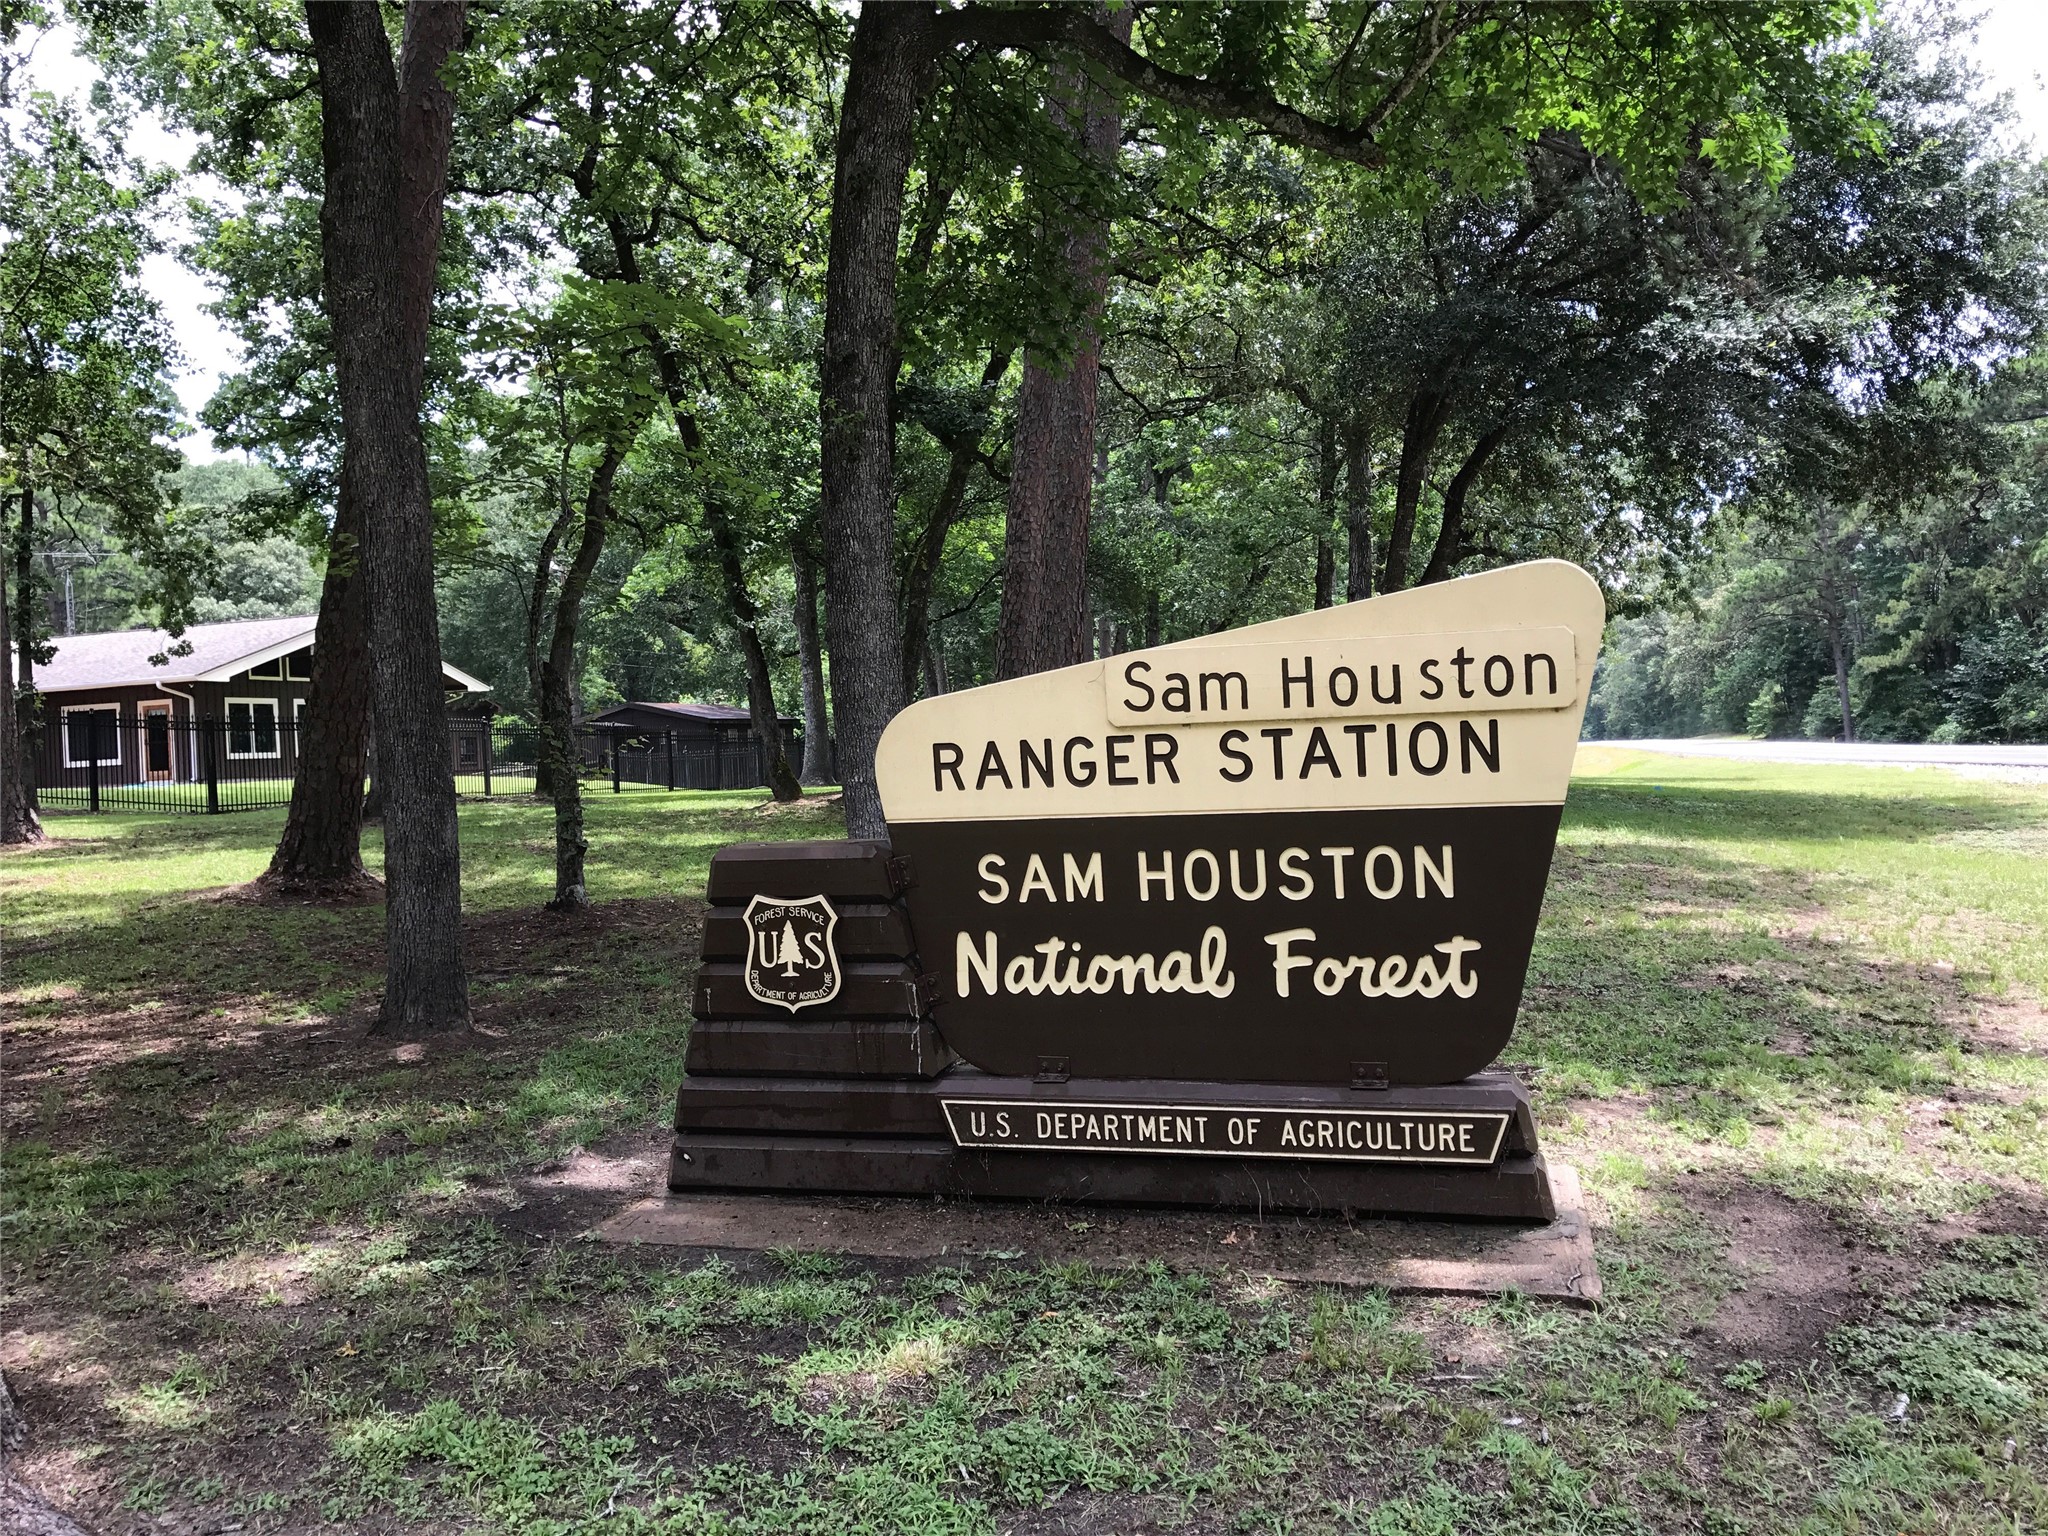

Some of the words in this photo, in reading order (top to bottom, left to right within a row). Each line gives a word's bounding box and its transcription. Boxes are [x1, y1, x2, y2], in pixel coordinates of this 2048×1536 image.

[1123, 660, 1248, 713] Sam
[1281, 646, 1557, 709] Houston
[932, 733, 1180, 792] RANGER
[1218, 718, 1500, 783] STATION
[977, 852, 1105, 904] SAM
[1138, 845, 1455, 902] HOUSTON
[754, 907, 785, 926] FOREST
[788, 907, 825, 926] SERVICE
[758, 931, 778, 968] U
[804, 932, 825, 969] S
[955, 925, 1236, 999] National
[1263, 927, 1482, 999] Forest
[751, 970, 785, 1000] DEPARTMENT
[787, 992, 797, 1000] OF
[799, 972, 833, 1000] AGRICULTURE
[970, 1111, 1019, 1138] U.S.
[1036, 1113, 1206, 1145] DEPARTMENT
[1228, 1118, 1261, 1146] OF
[1281, 1119, 1475, 1153] AGRICULTURE
